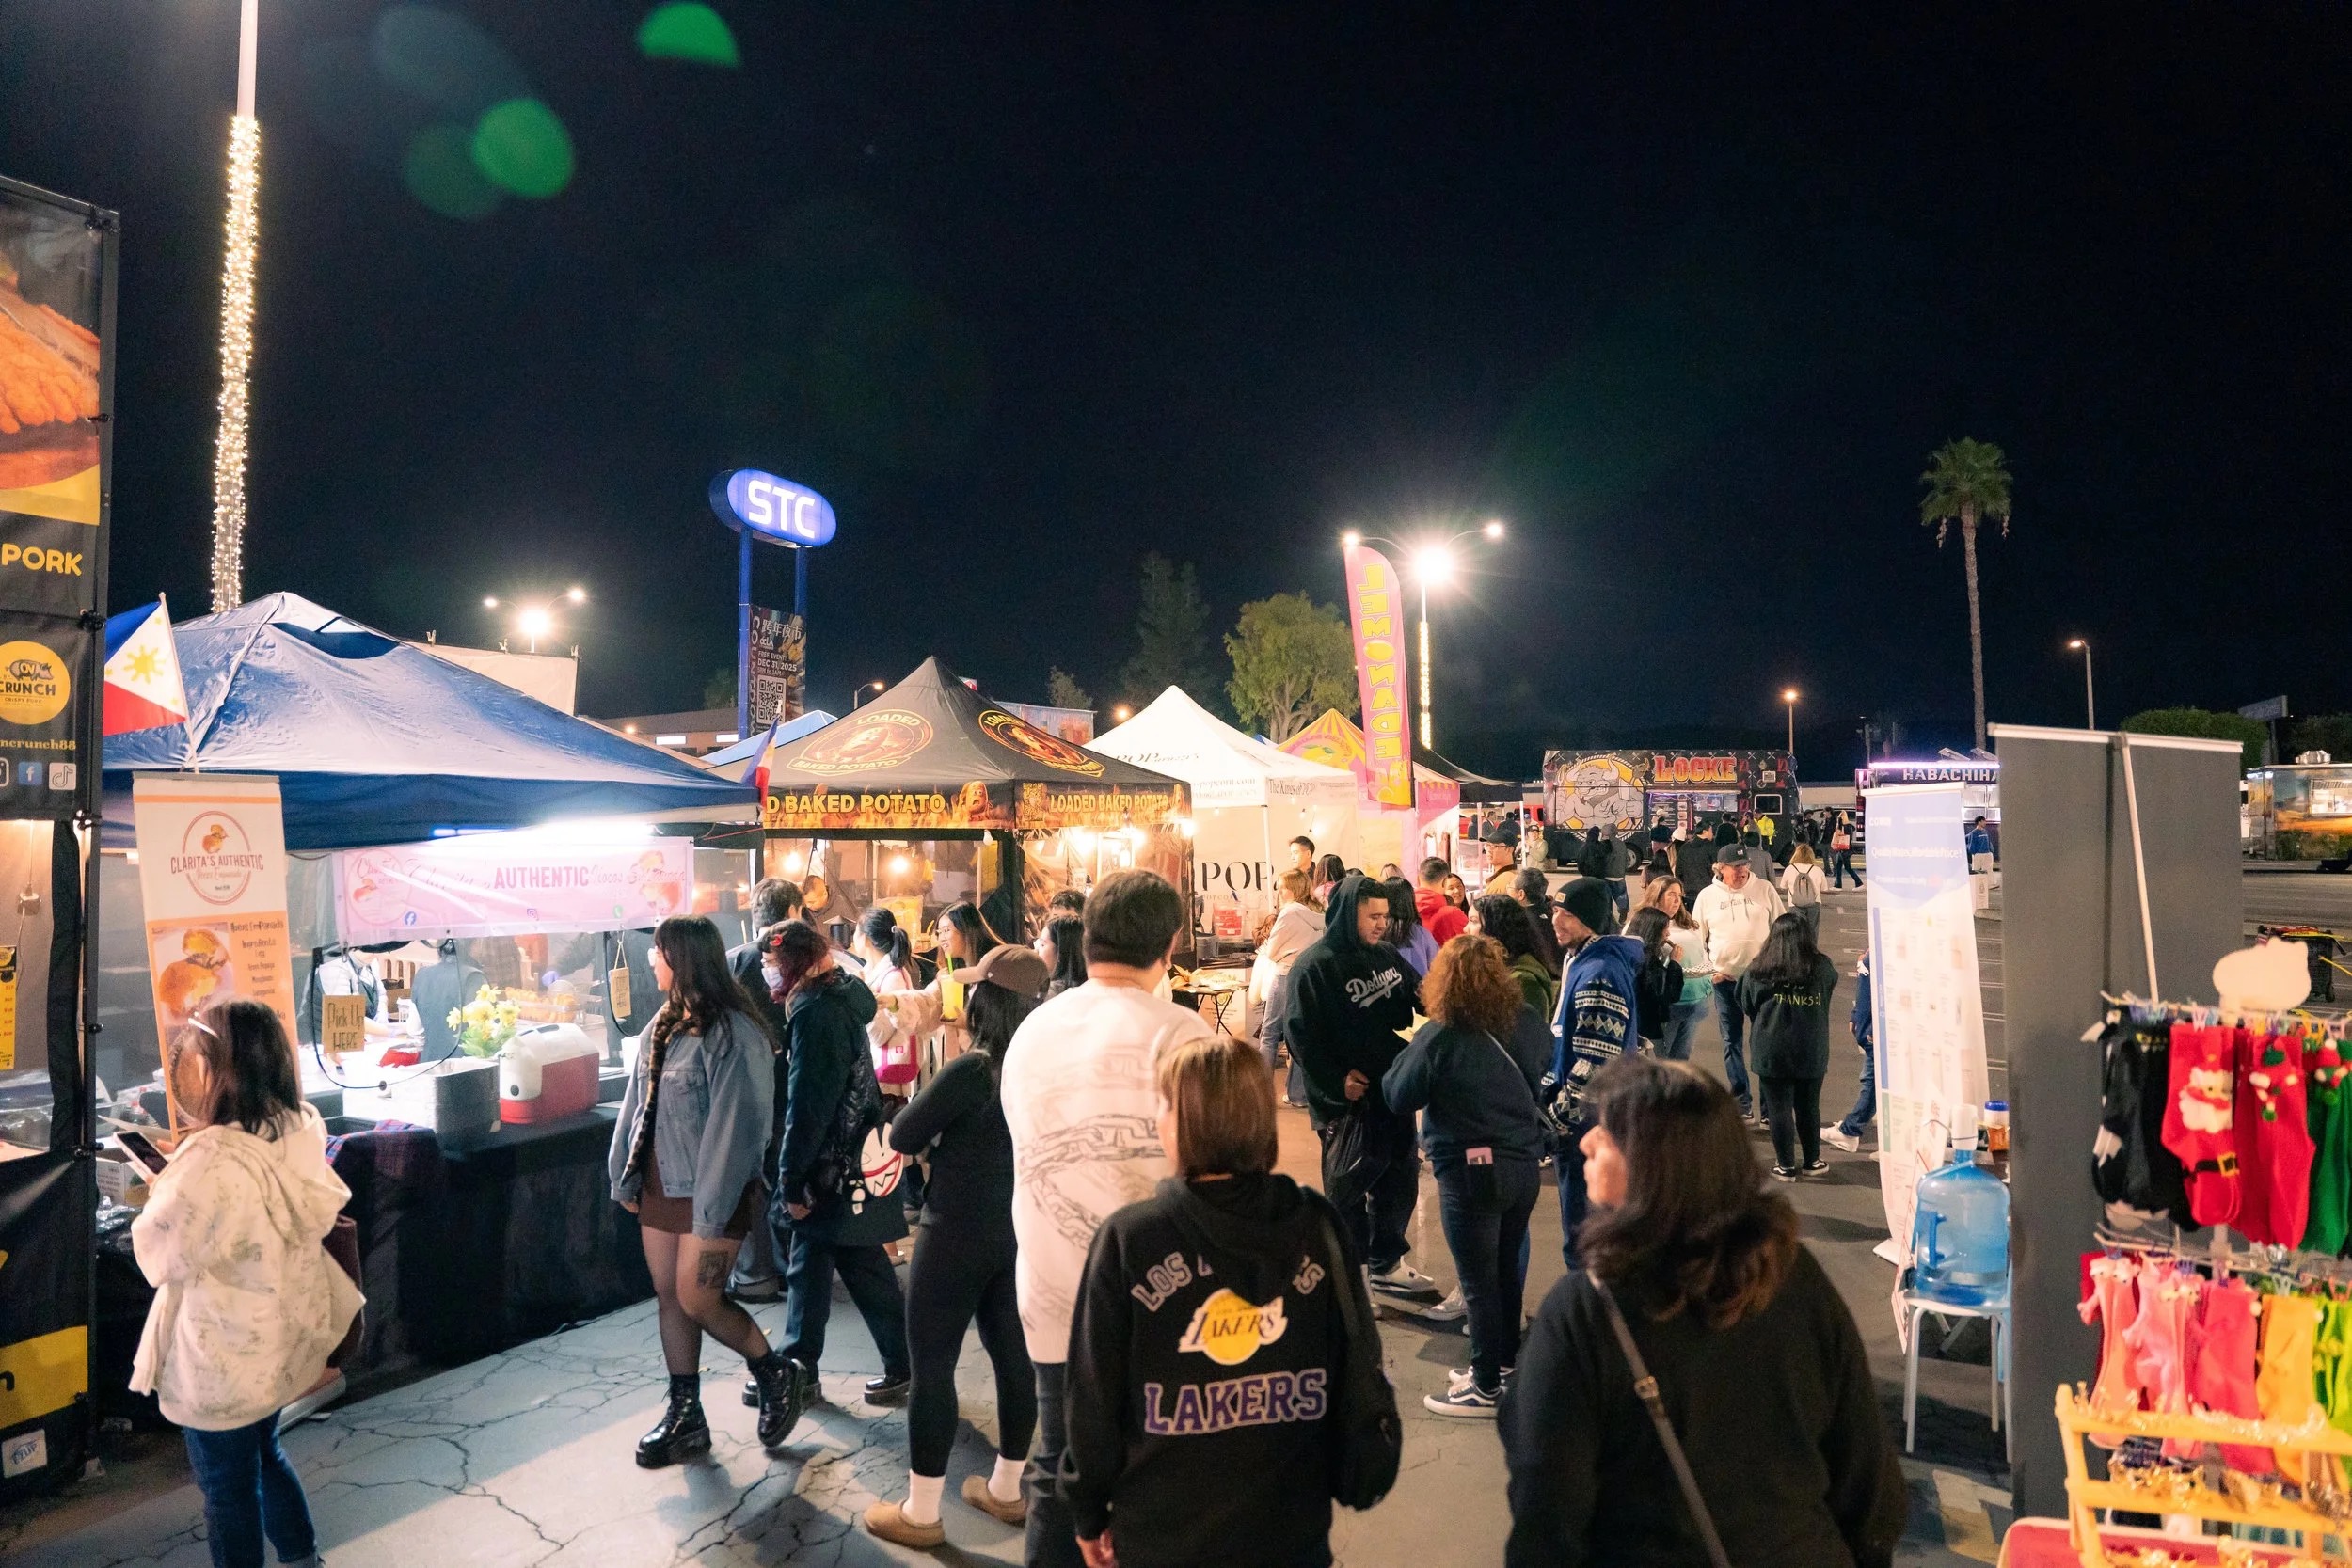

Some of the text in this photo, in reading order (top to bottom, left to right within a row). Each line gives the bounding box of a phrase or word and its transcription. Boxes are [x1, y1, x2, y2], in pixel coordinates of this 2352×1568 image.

[748, 479, 815, 539] STC
[2, 543, 83, 576] PORK
[757, 658, 771, 668] DEC
[781, 662, 798, 673] 2025
[857, 713, 921, 726] LOADED
[793, 759, 898, 770] BAKED POTATO
[1653, 755, 1738, 784] LOCKE
[785, 794, 855, 814] BAKED
[860, 793, 946, 814] POTATO
[1050, 794, 1169, 813] LOADED BAKED POTATO
[170, 855, 215, 875] CLARITA'S
[218, 853, 264, 871] AUTHENTIC
[495, 866, 589, 889] AUTHENTIC
[1345, 966, 1402, 1005] Dodgers
[327, 1003, 365, 1031] Pick Up
[333, 1031, 358, 1051] HERE
[1131, 1251, 1193, 1312] LOS
[1144, 1367, 1327, 1435] LAKERS
